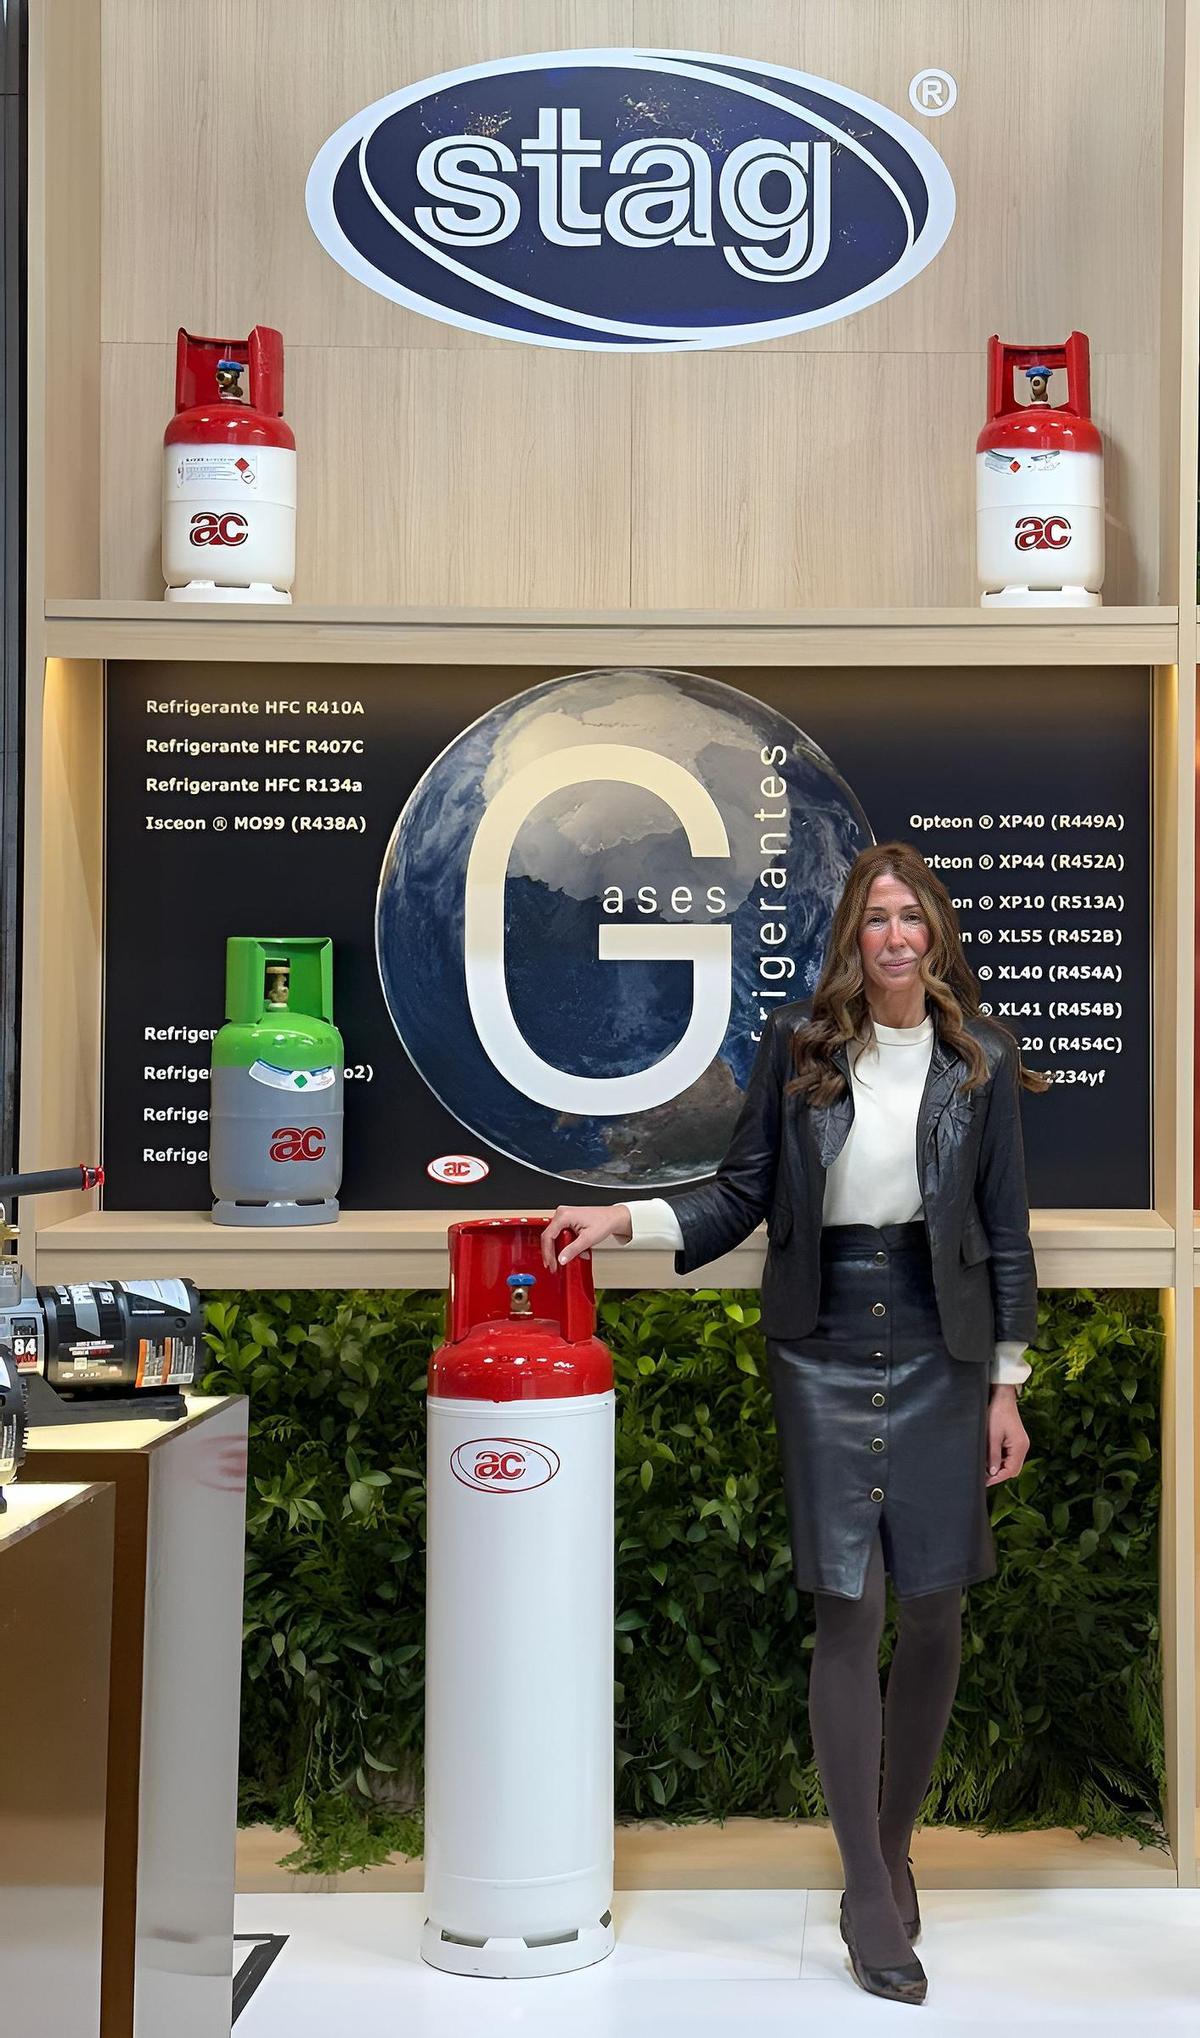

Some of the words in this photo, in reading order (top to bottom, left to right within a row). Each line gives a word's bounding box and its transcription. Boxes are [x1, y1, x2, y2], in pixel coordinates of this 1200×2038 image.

[414, 107, 832, 283] stag
[189, 511, 249, 547] ac
[1014, 516, 1072, 551] ac
[146, 699, 259, 717] Refrigerante
[265, 700, 301, 714] HFC
[306, 700, 365, 715] R410A
[146, 738, 259, 756] Refrigerante
[265, 739, 300, 754] HFC
[306, 739, 364, 754] R407C
[146, 777, 259, 795] Refrigerante
[265, 778, 301, 792] HFC
[306, 778, 363, 793] R134a
[146, 816, 206, 830] Isceon
[291, 815, 367, 834] (R438A)
[909, 814, 973, 831] Opteon
[998, 814, 1045, 829] XP40
[1051, 814, 1125, 831] (R449A)
[923, 854, 973, 869] pteon
[998, 854, 1045, 869] XP44
[1050, 853, 1125, 872] (R452A)
[998, 895, 1045, 910] XP10
[1051, 894, 1125, 912] (R513A)
[998, 929, 1043, 943] XL55
[1048, 928, 1122, 946] (R452B)
[998, 965, 1043, 980] XL40
[1048, 964, 1123, 983] (R454A)
[998, 1002, 1042, 1016] XL41
[1048, 1001, 1123, 1020] (R454B)
[144, 1025, 218, 1044] Refriger
[1017, 1036, 1044, 1052] 20
[1049, 1036, 1123, 1054] (R454C)
[144, 1065, 212, 1083] Refrige
[343, 1064, 374, 1082] o2)
[143, 1106, 209, 1124] Refrige
[269, 1126, 326, 1163] ac
[142, 1147, 208, 1165] Refrige
[14, 1338, 36, 1355] 84
[474, 1450, 526, 1481] ac
